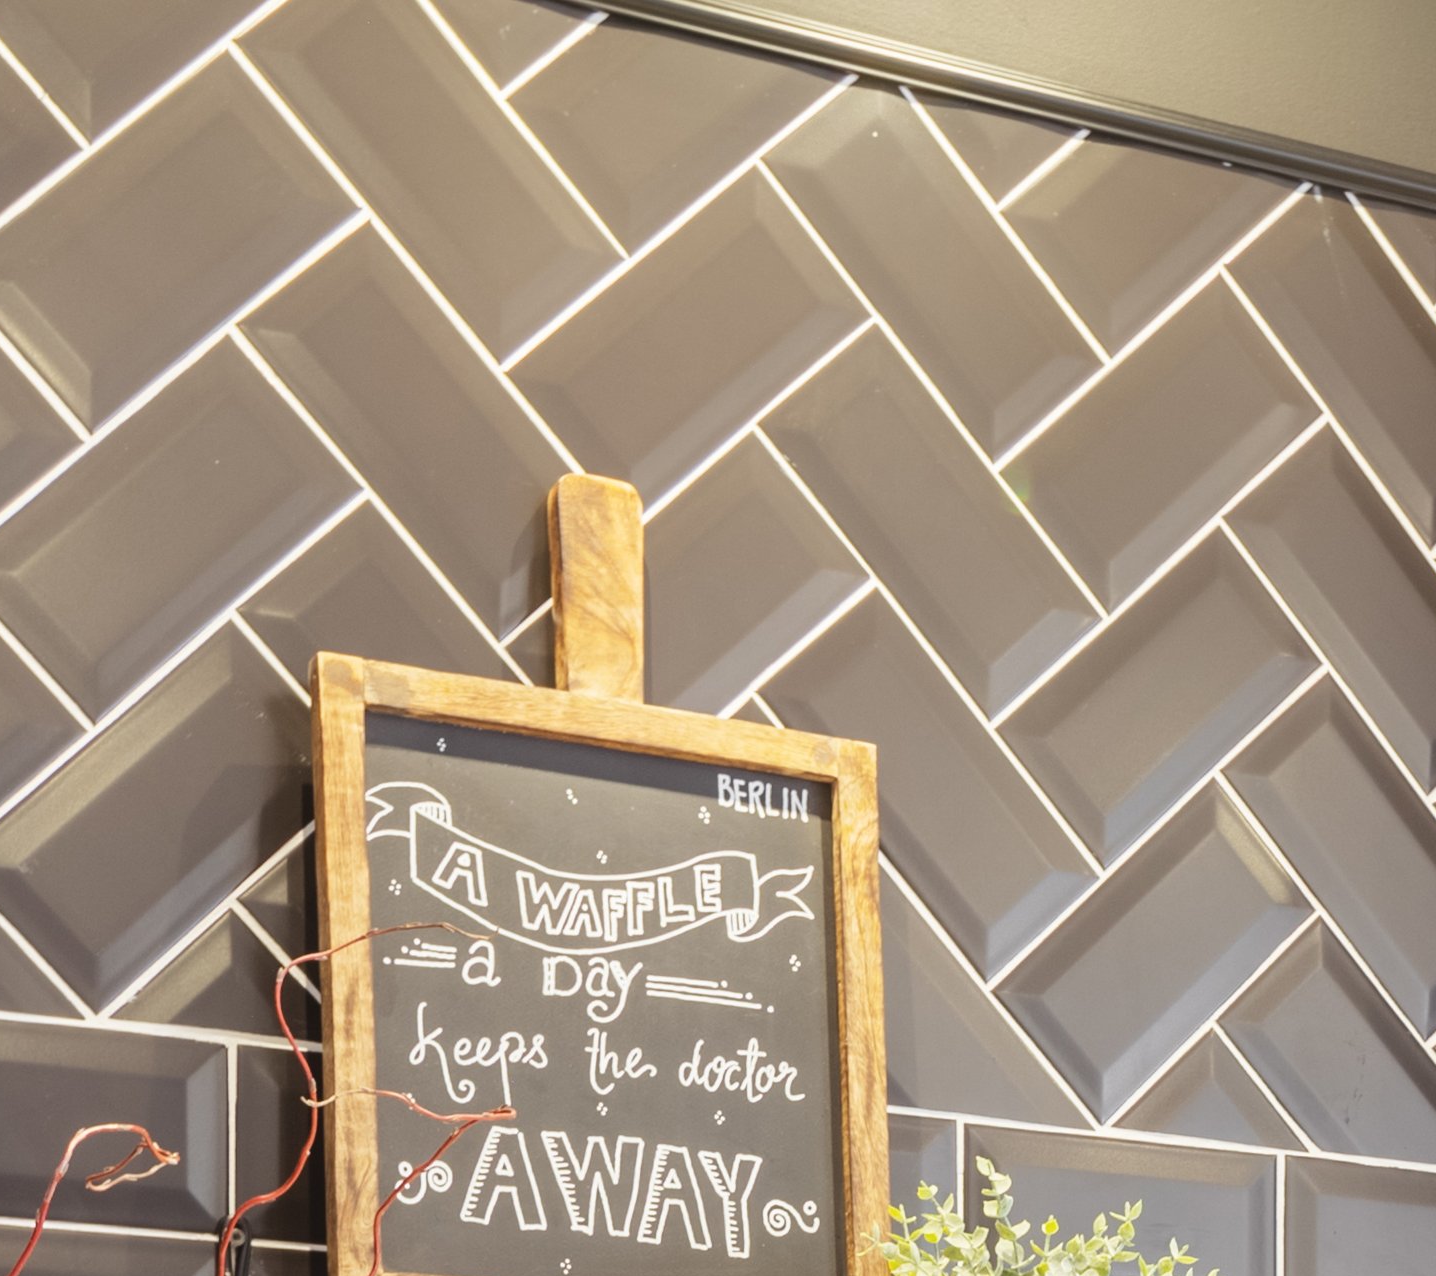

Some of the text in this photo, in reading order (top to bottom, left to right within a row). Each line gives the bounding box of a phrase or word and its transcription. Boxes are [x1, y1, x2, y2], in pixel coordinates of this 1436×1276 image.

[717, 773, 809, 823] BERLIN
[432, 842, 722, 942] A WAFFLE
[462, 940, 501, 987] a
[585, 1028, 657, 1095] the
[678, 1038, 806, 1102] doctor
[460, 1124, 763, 1258] AWAY
